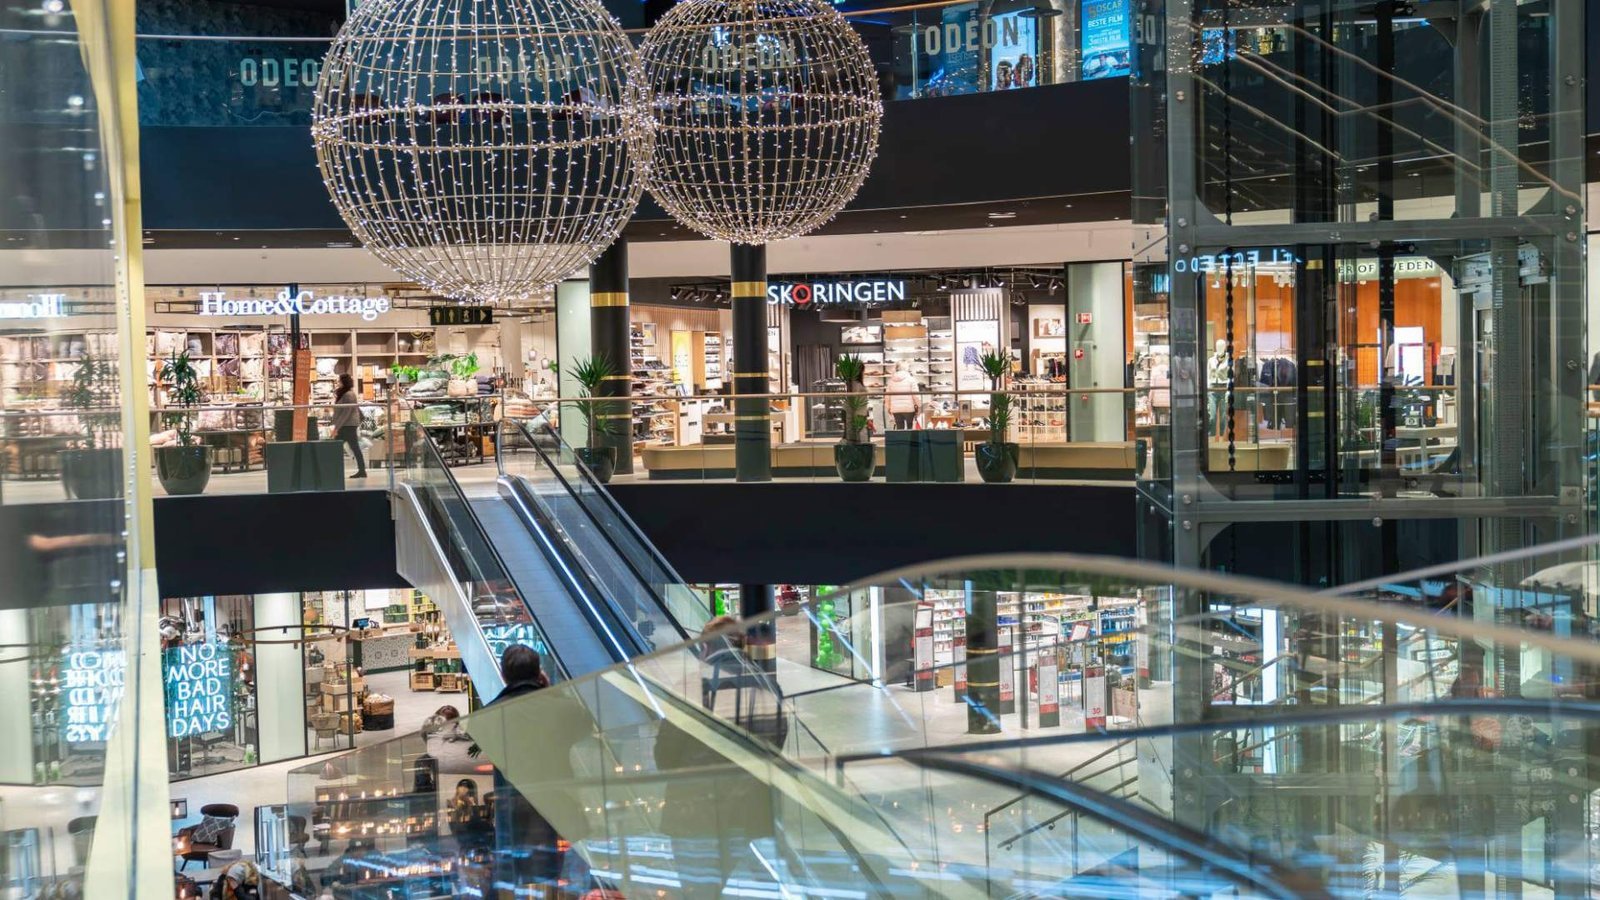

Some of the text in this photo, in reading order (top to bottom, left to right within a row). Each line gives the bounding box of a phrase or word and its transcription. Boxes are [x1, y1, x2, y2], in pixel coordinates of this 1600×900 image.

[1087, 15, 1123, 28] BESTE FILM
[925, 16, 1018, 56] ODEON
[702, 40, 795, 73] ODEON
[478, 55, 571, 84] ODEON
[198, 287, 389, 321] Home&Cottage
[767, 281, 904, 304] SKORINGEN
[180, 643, 215, 664] NO
[168, 658, 230, 683] MORE
[178, 678, 221, 700] BAD
[175, 695, 225, 719] HAIR
[172, 711, 230, 737] DAYS
